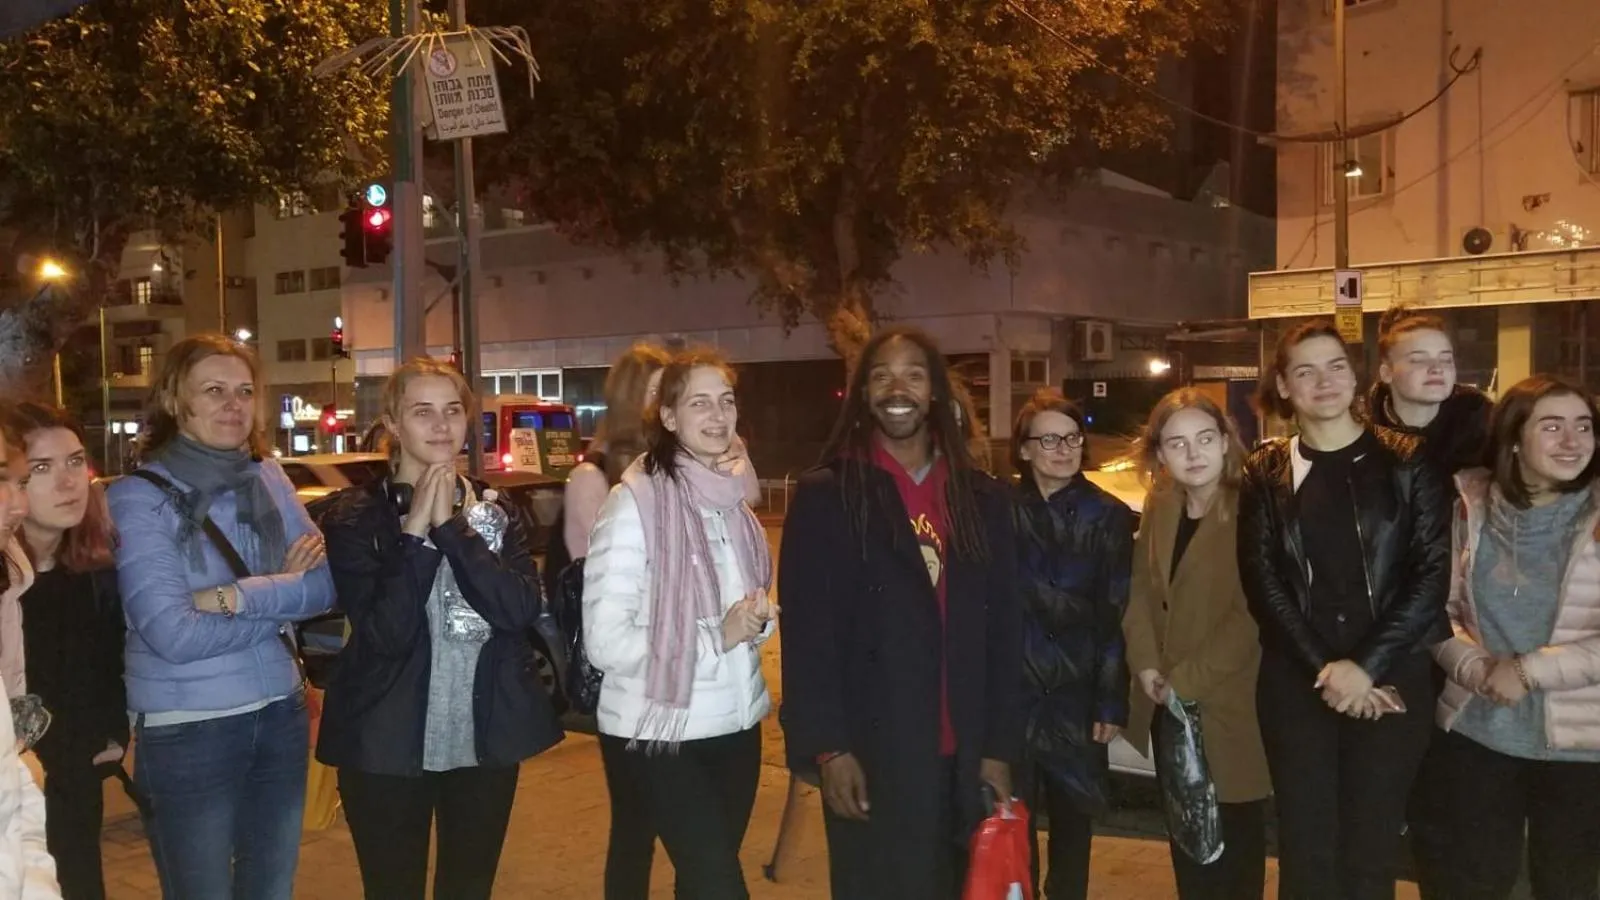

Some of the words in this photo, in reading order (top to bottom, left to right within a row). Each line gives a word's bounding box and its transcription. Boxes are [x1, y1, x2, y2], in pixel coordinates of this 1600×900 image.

[467, 75, 492, 88] מתח
[467, 87, 495, 102] סכנת
[438, 108, 464, 119] Danger
[466, 103, 473, 115] of
